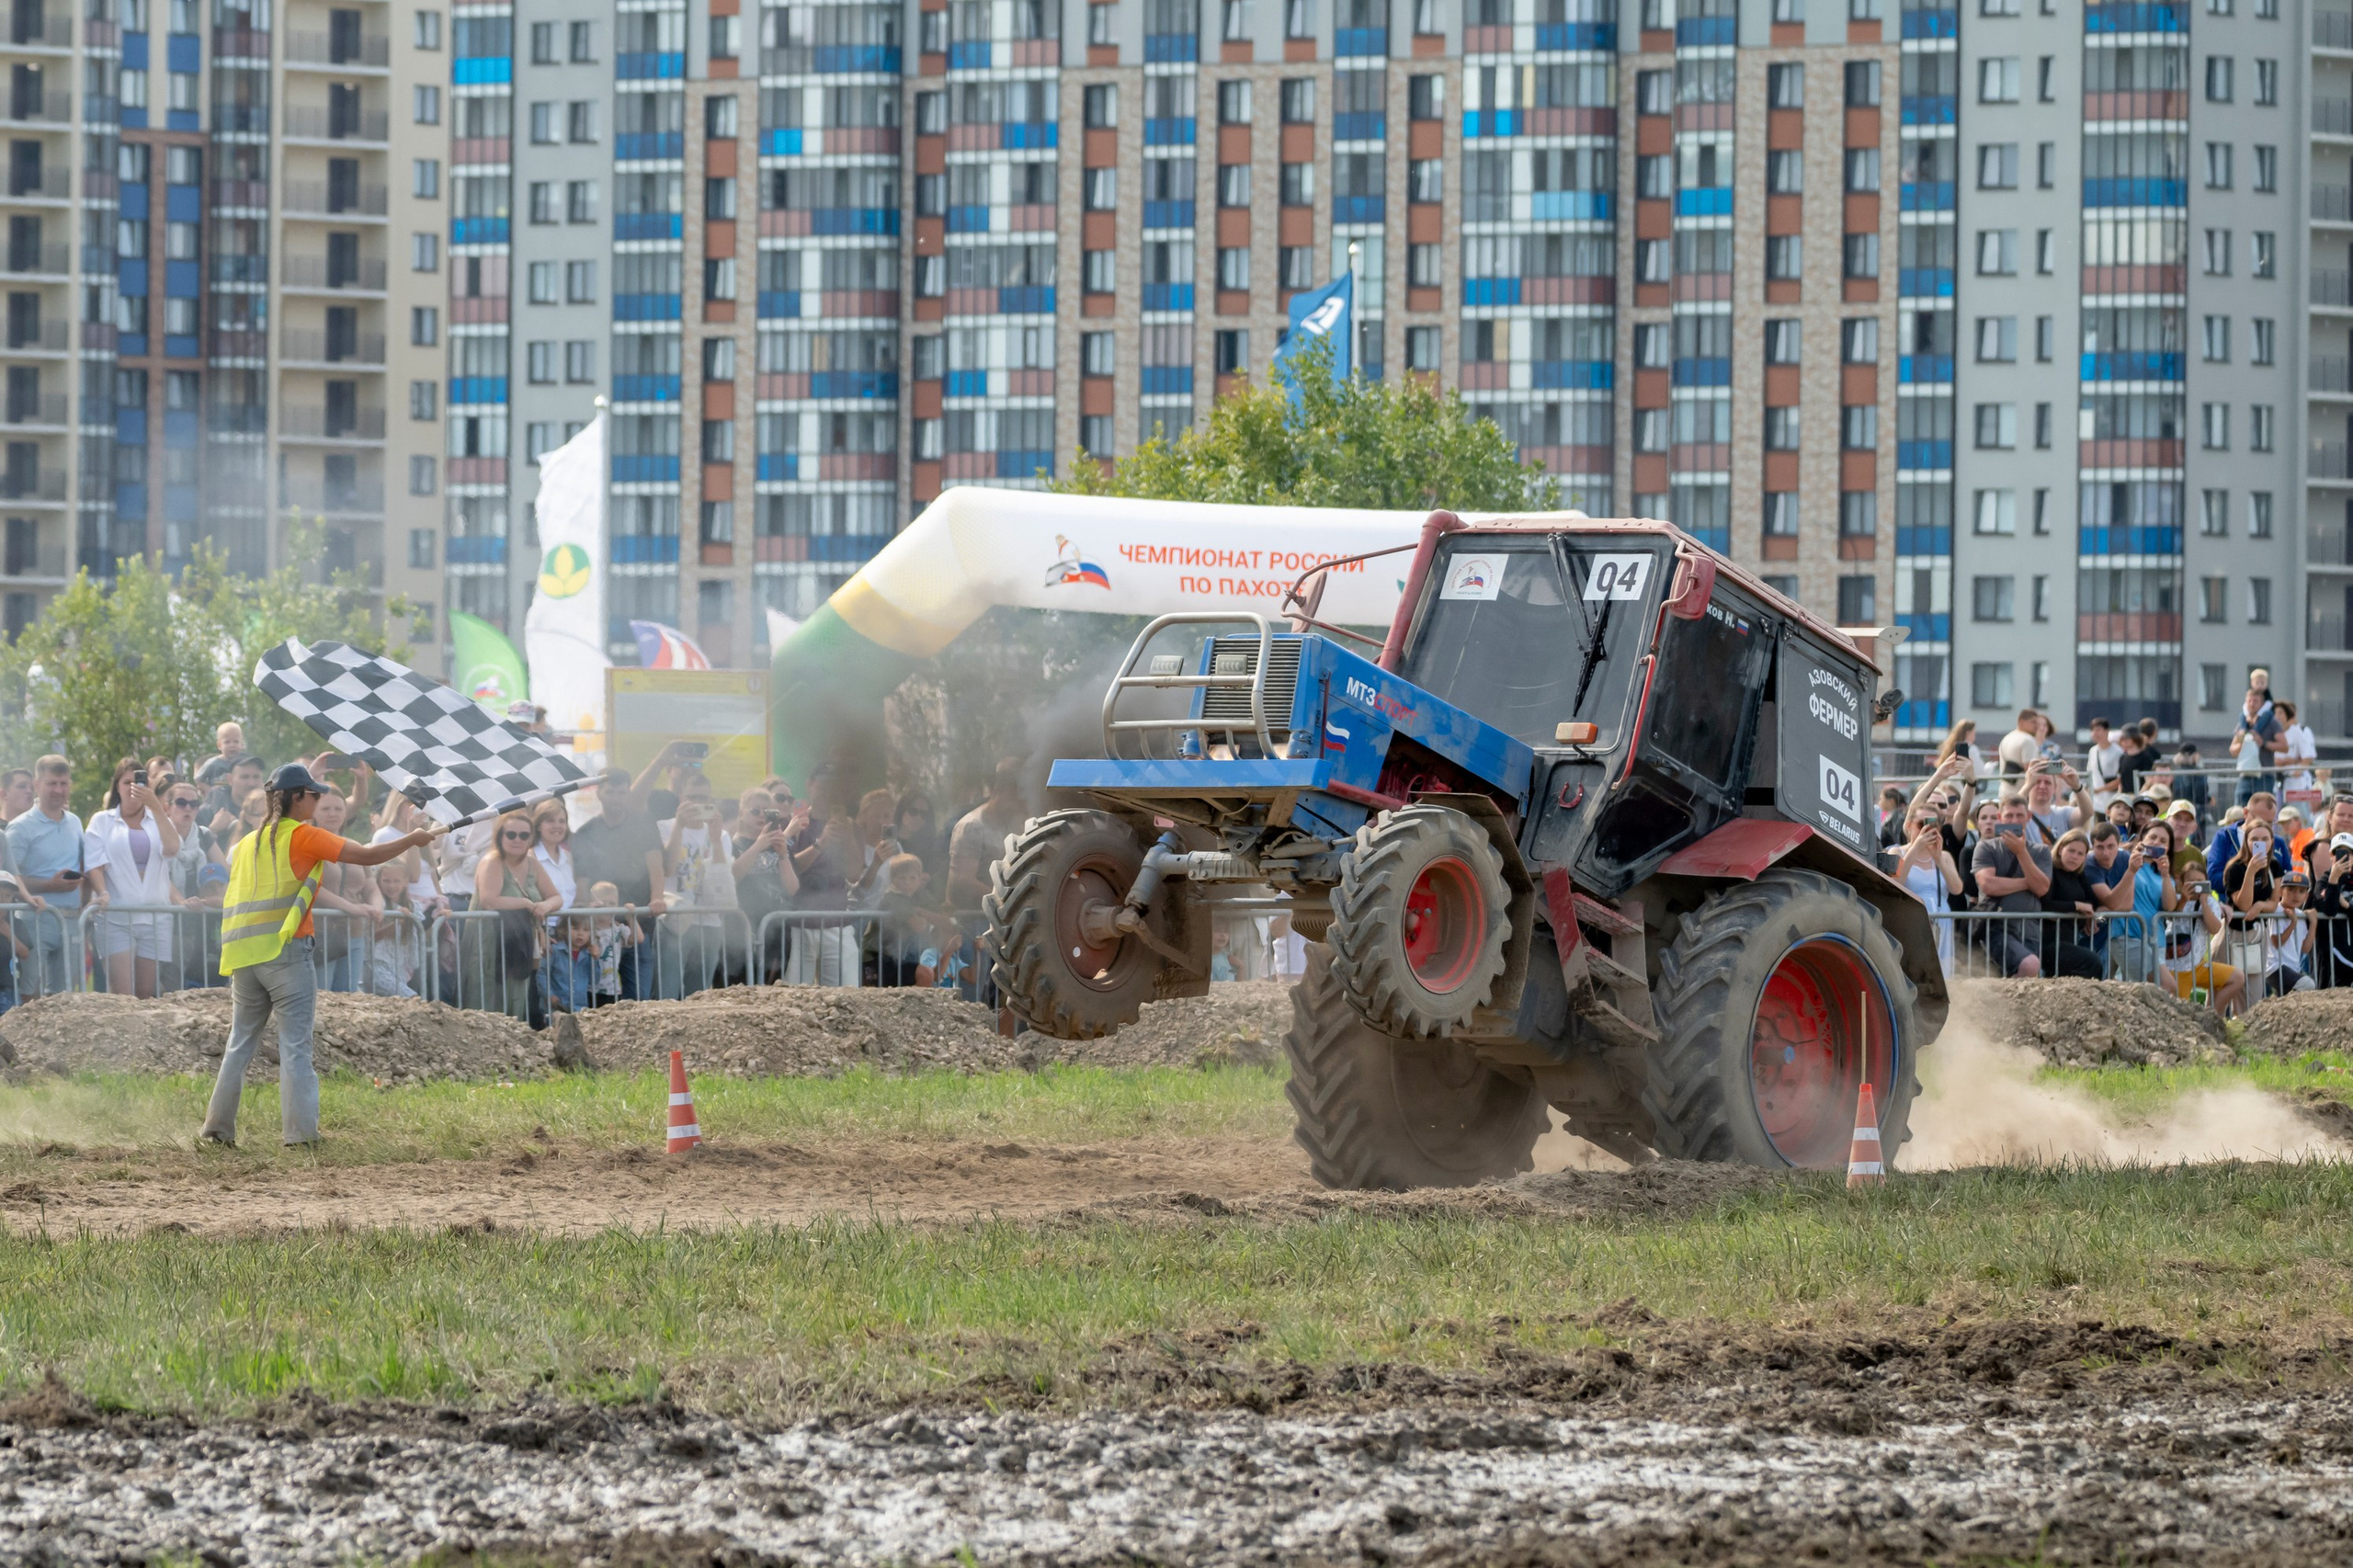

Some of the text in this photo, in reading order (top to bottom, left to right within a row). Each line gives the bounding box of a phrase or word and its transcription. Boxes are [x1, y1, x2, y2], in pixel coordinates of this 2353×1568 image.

[1120, 544, 1263, 569] ЧЕМПИОНАТ
[1180, 576, 1211, 594] ПО
[1597, 562, 1639, 592] 04
[1809, 668, 1858, 711] АЗОВСКИЙ
[1809, 692, 1858, 741] ФЕРМЕР
[1826, 767, 1855, 811] 04
[1829, 816, 1859, 844] BELARUS
